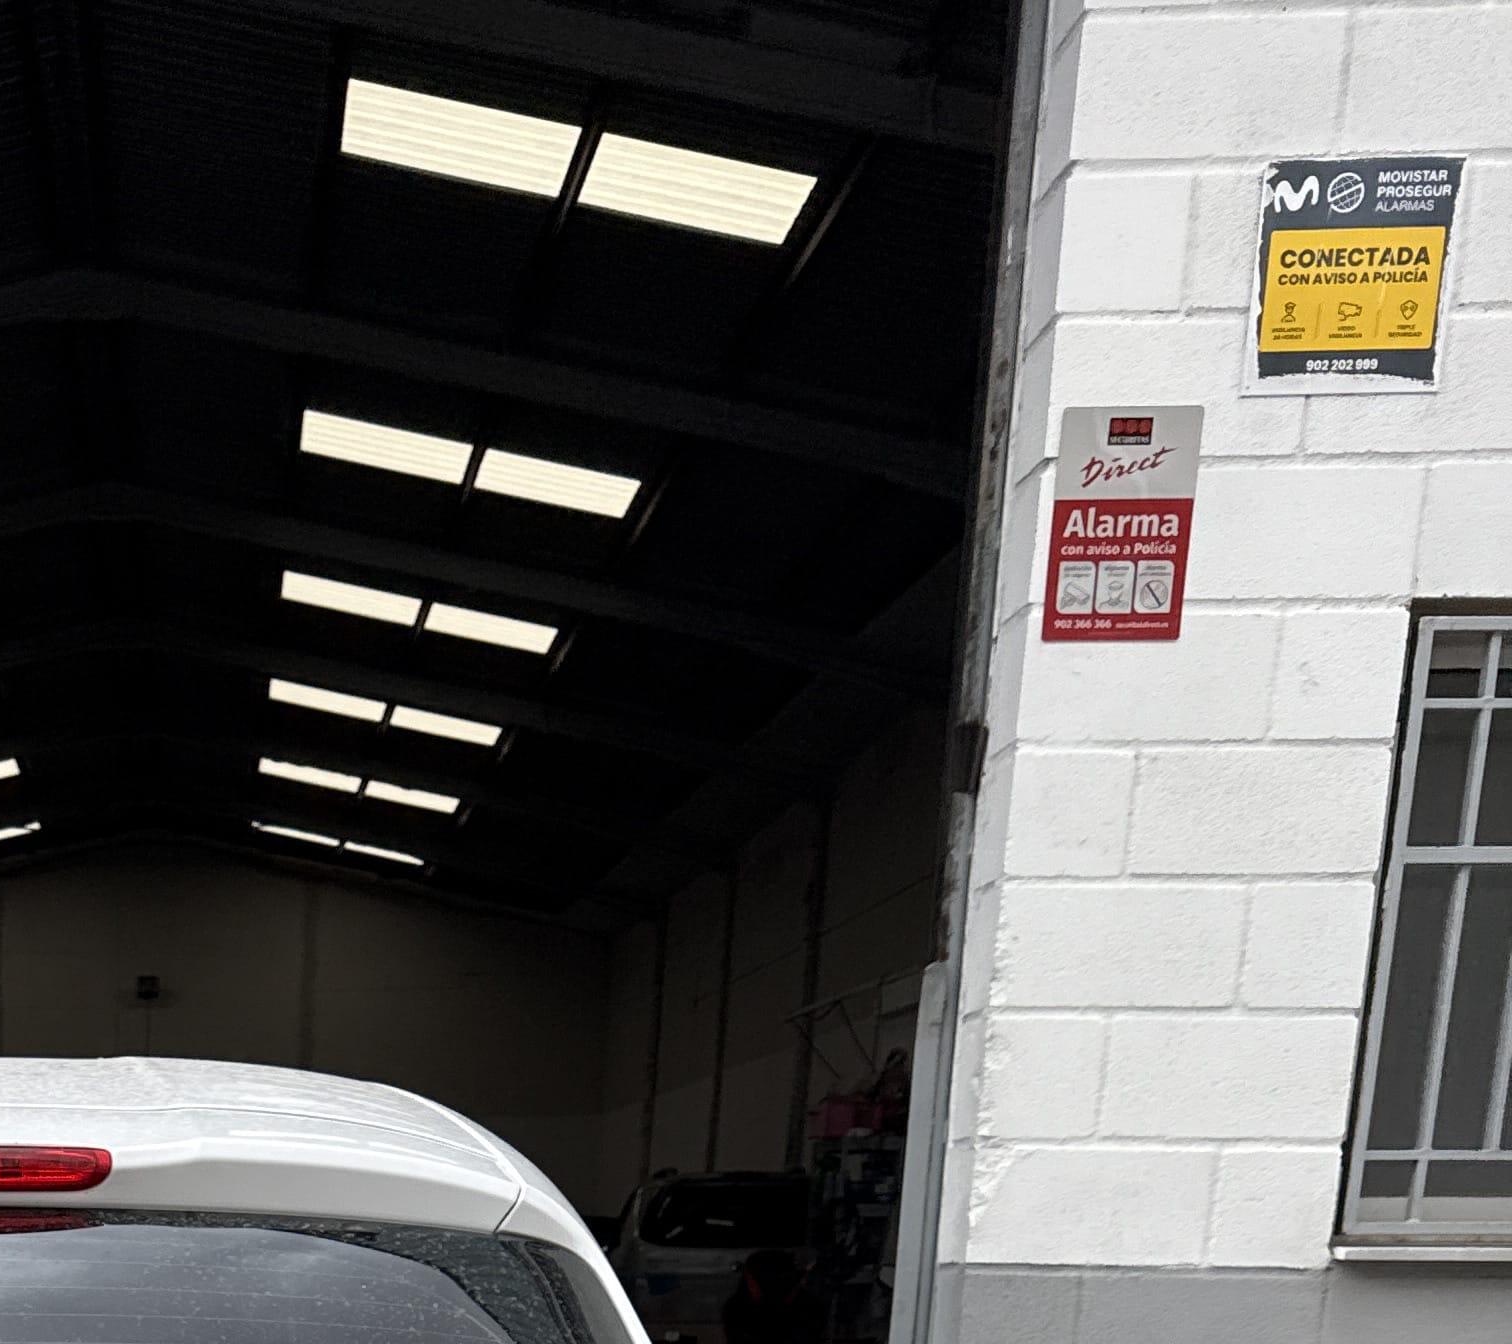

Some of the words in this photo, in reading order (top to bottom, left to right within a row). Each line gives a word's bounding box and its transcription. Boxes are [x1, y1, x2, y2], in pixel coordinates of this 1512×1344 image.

[1377, 169, 1449, 184] MOVISTAR
[1376, 184, 1452, 198] PROSEGUR
[1374, 199, 1435, 213] ALARMAS
[1280, 246, 1431, 269] CONECTADA
[1277, 273, 1310, 286] CON
[1312, 272, 1358, 285] AVISO
[1359, 272, 1370, 284] A
[1373, 267, 1428, 284] POLICÍA
[1305, 359, 1329, 371] 902
[1330, 359, 1354, 371] 202
[1080, 446, 1179, 488] Direct
[1062, 506, 1180, 538] Alarma
[1060, 544, 1084, 556] con
[1086, 541, 1120, 555] aviso
[1122, 544, 1131, 555] a
[1133, 540, 1177, 555] Policía
